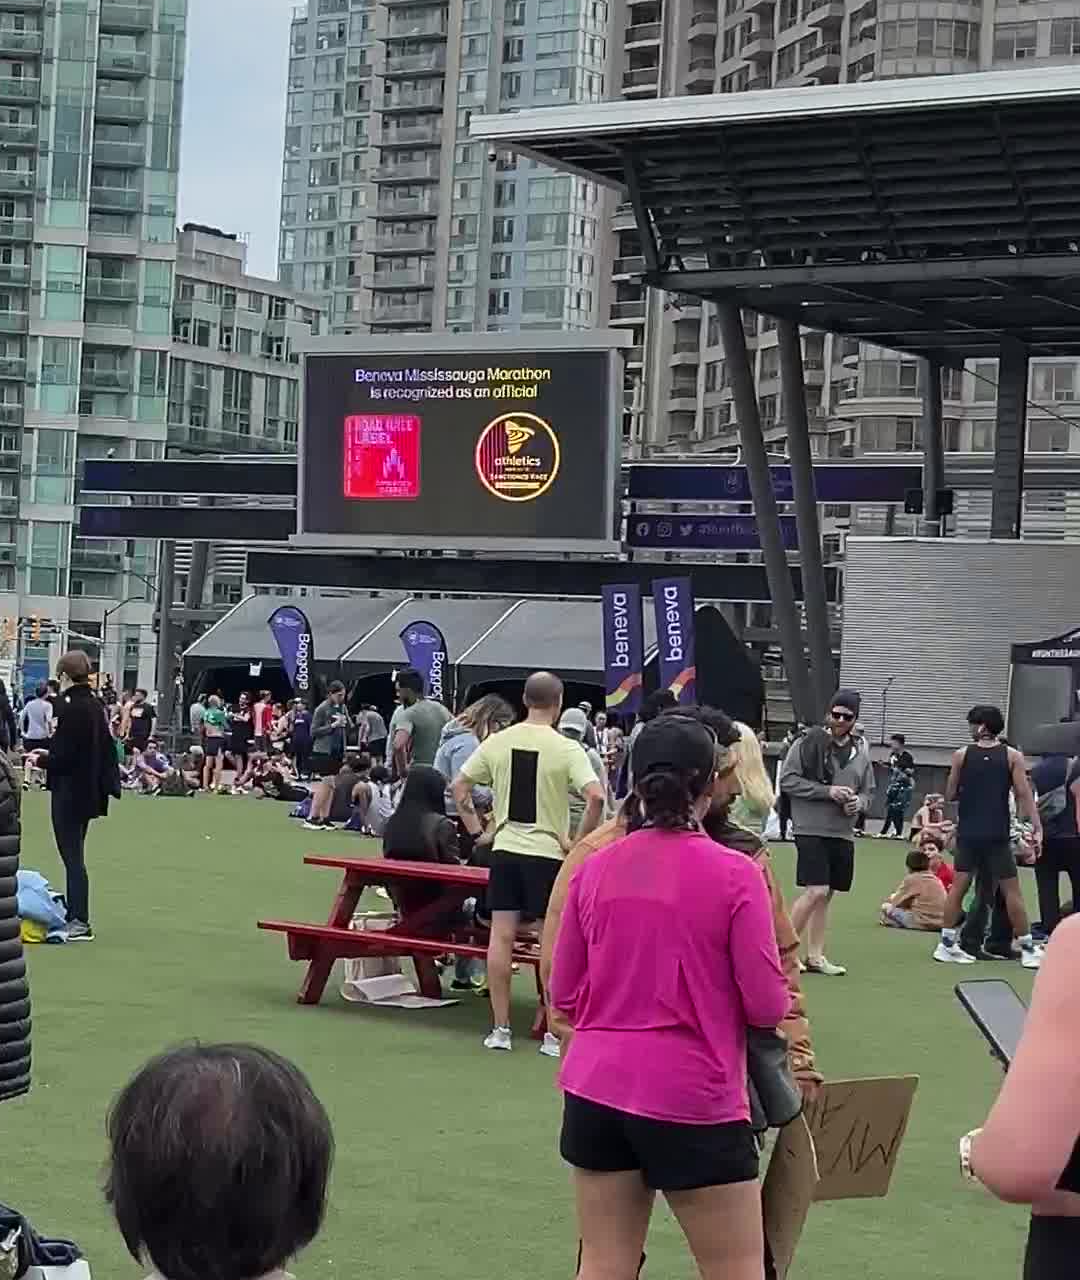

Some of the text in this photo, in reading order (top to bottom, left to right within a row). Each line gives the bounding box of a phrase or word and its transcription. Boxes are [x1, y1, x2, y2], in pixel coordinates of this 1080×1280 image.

[355, 367, 551, 384] Beneva Mississauga Marathon
[370, 384, 538, 401] is recognized as an official
[494, 456, 541, 467] athletics
[611, 592, 629, 667] beneva
[664, 586, 683, 662] beneva
[296, 633, 310, 690] Baggage
